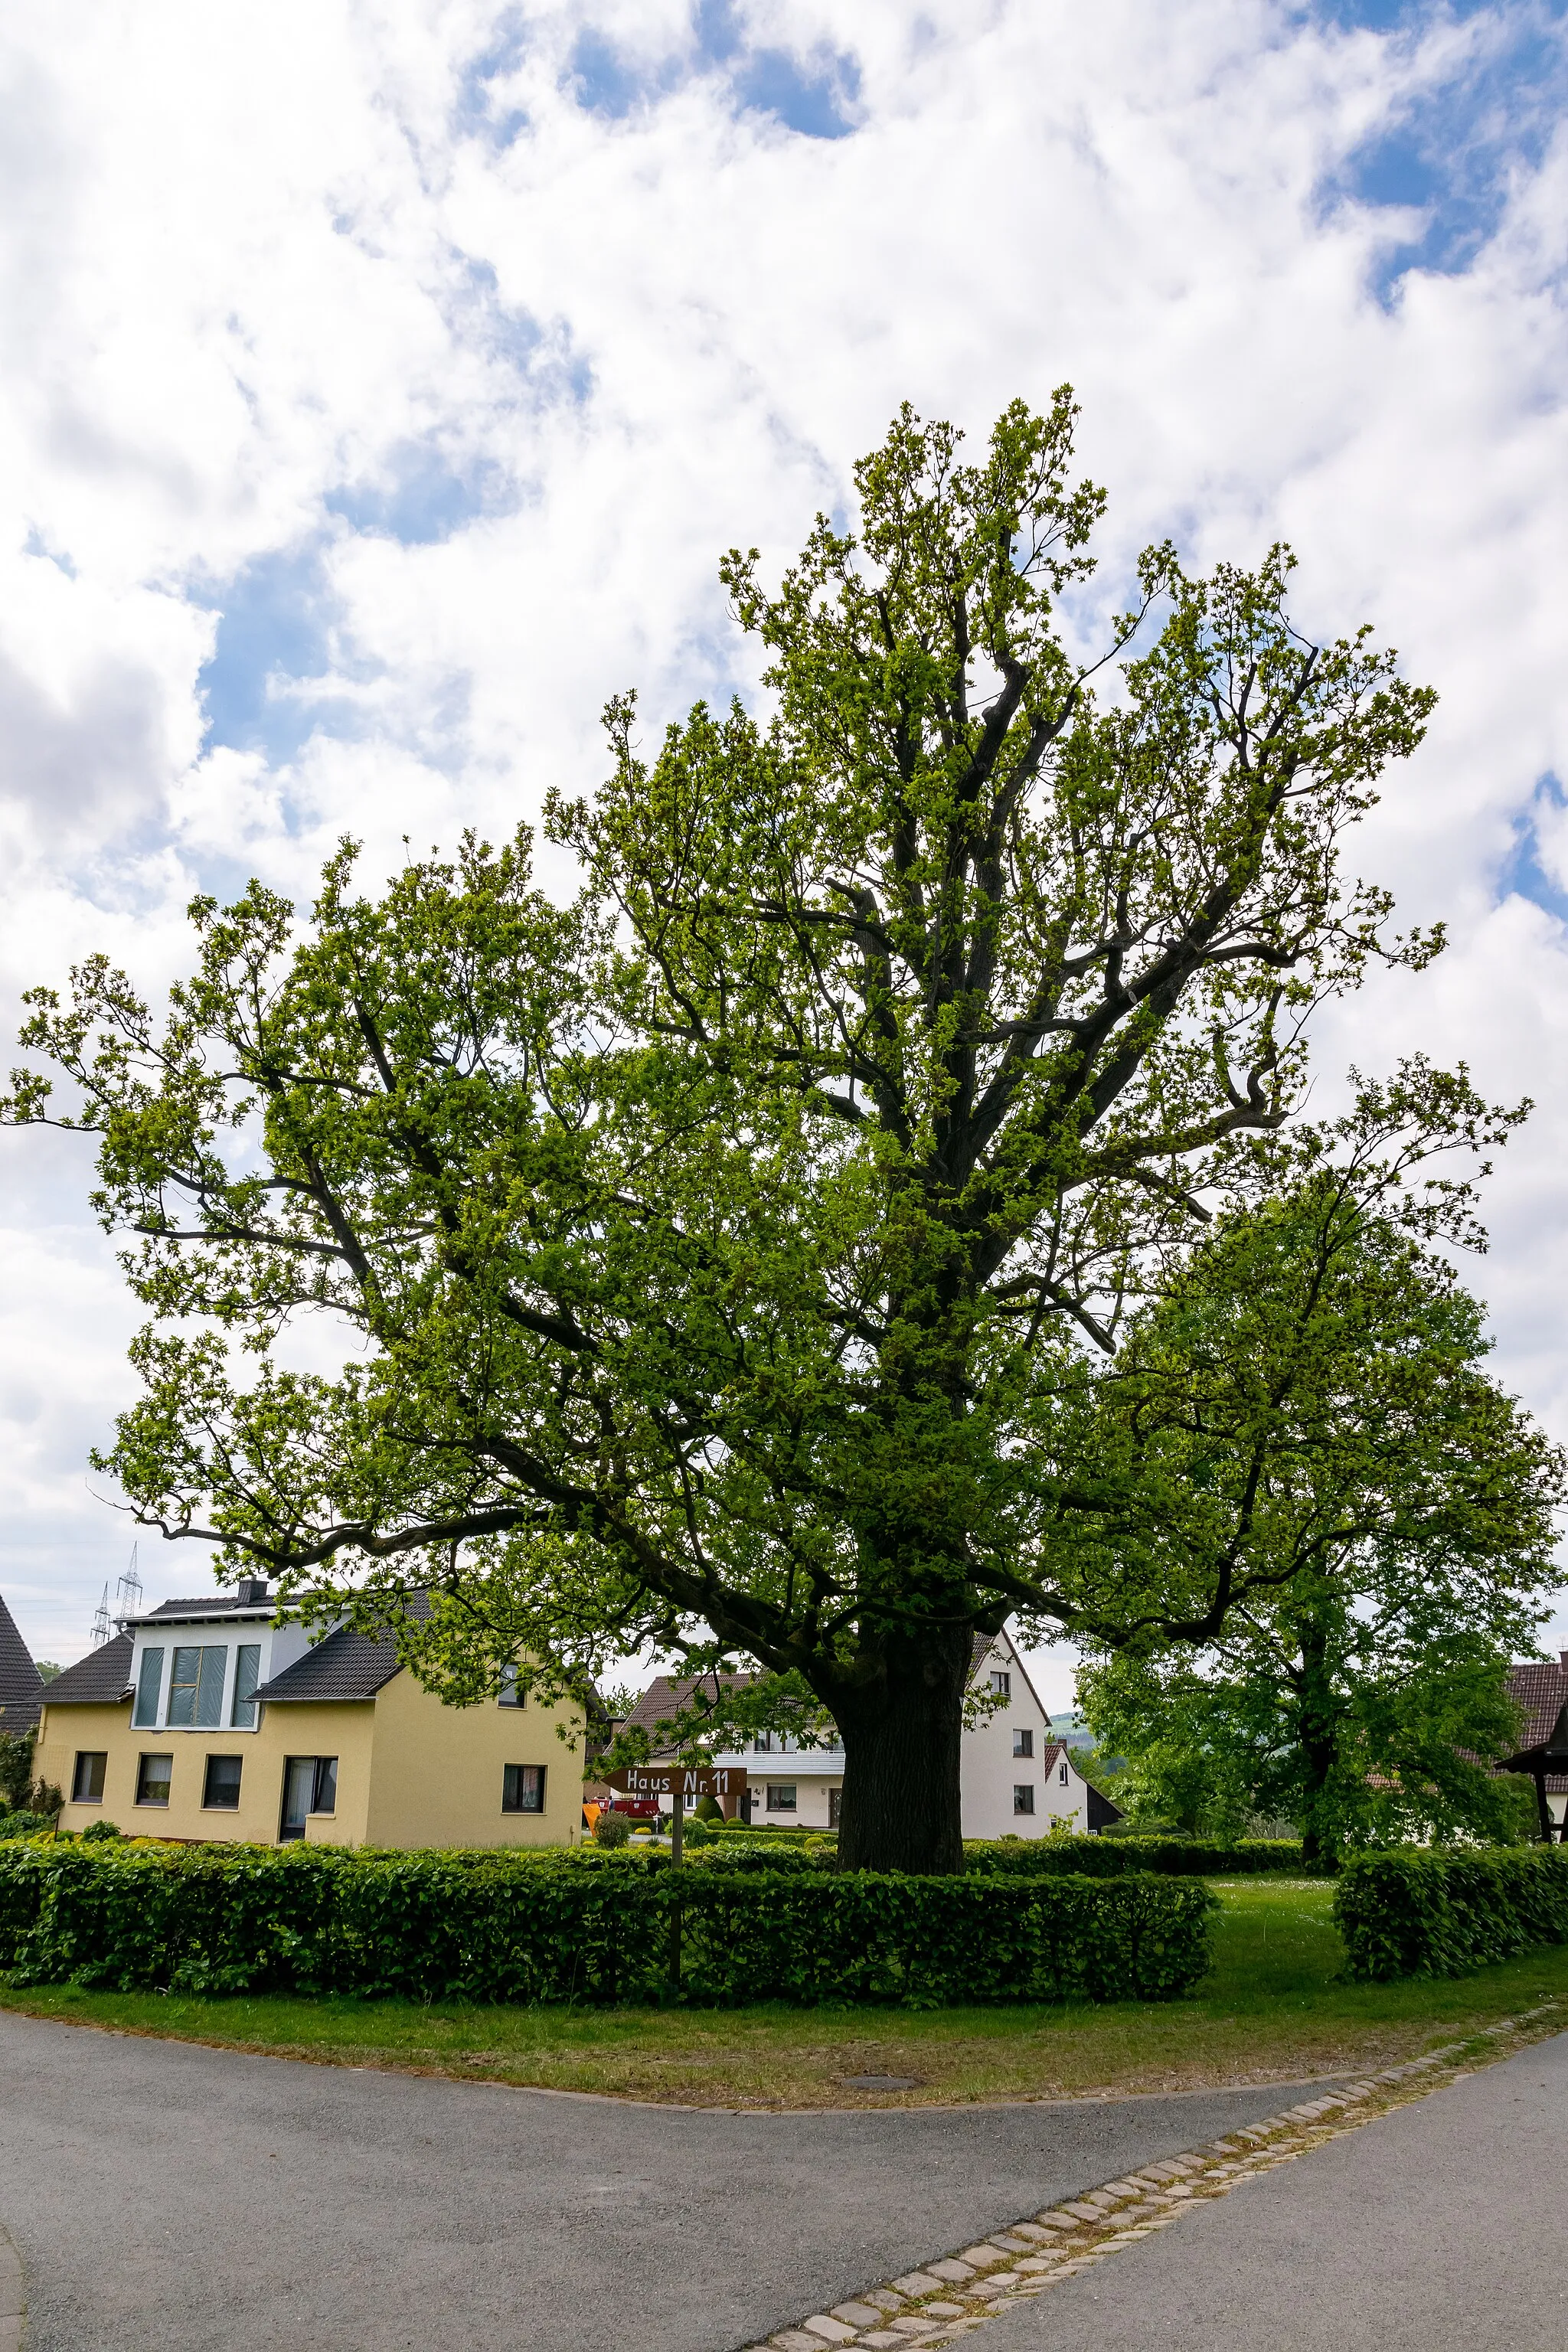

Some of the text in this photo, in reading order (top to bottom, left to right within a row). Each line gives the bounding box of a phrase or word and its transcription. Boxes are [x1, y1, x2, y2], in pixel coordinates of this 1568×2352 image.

[627, 1770, 728, 1793] Haus Nr. 11
